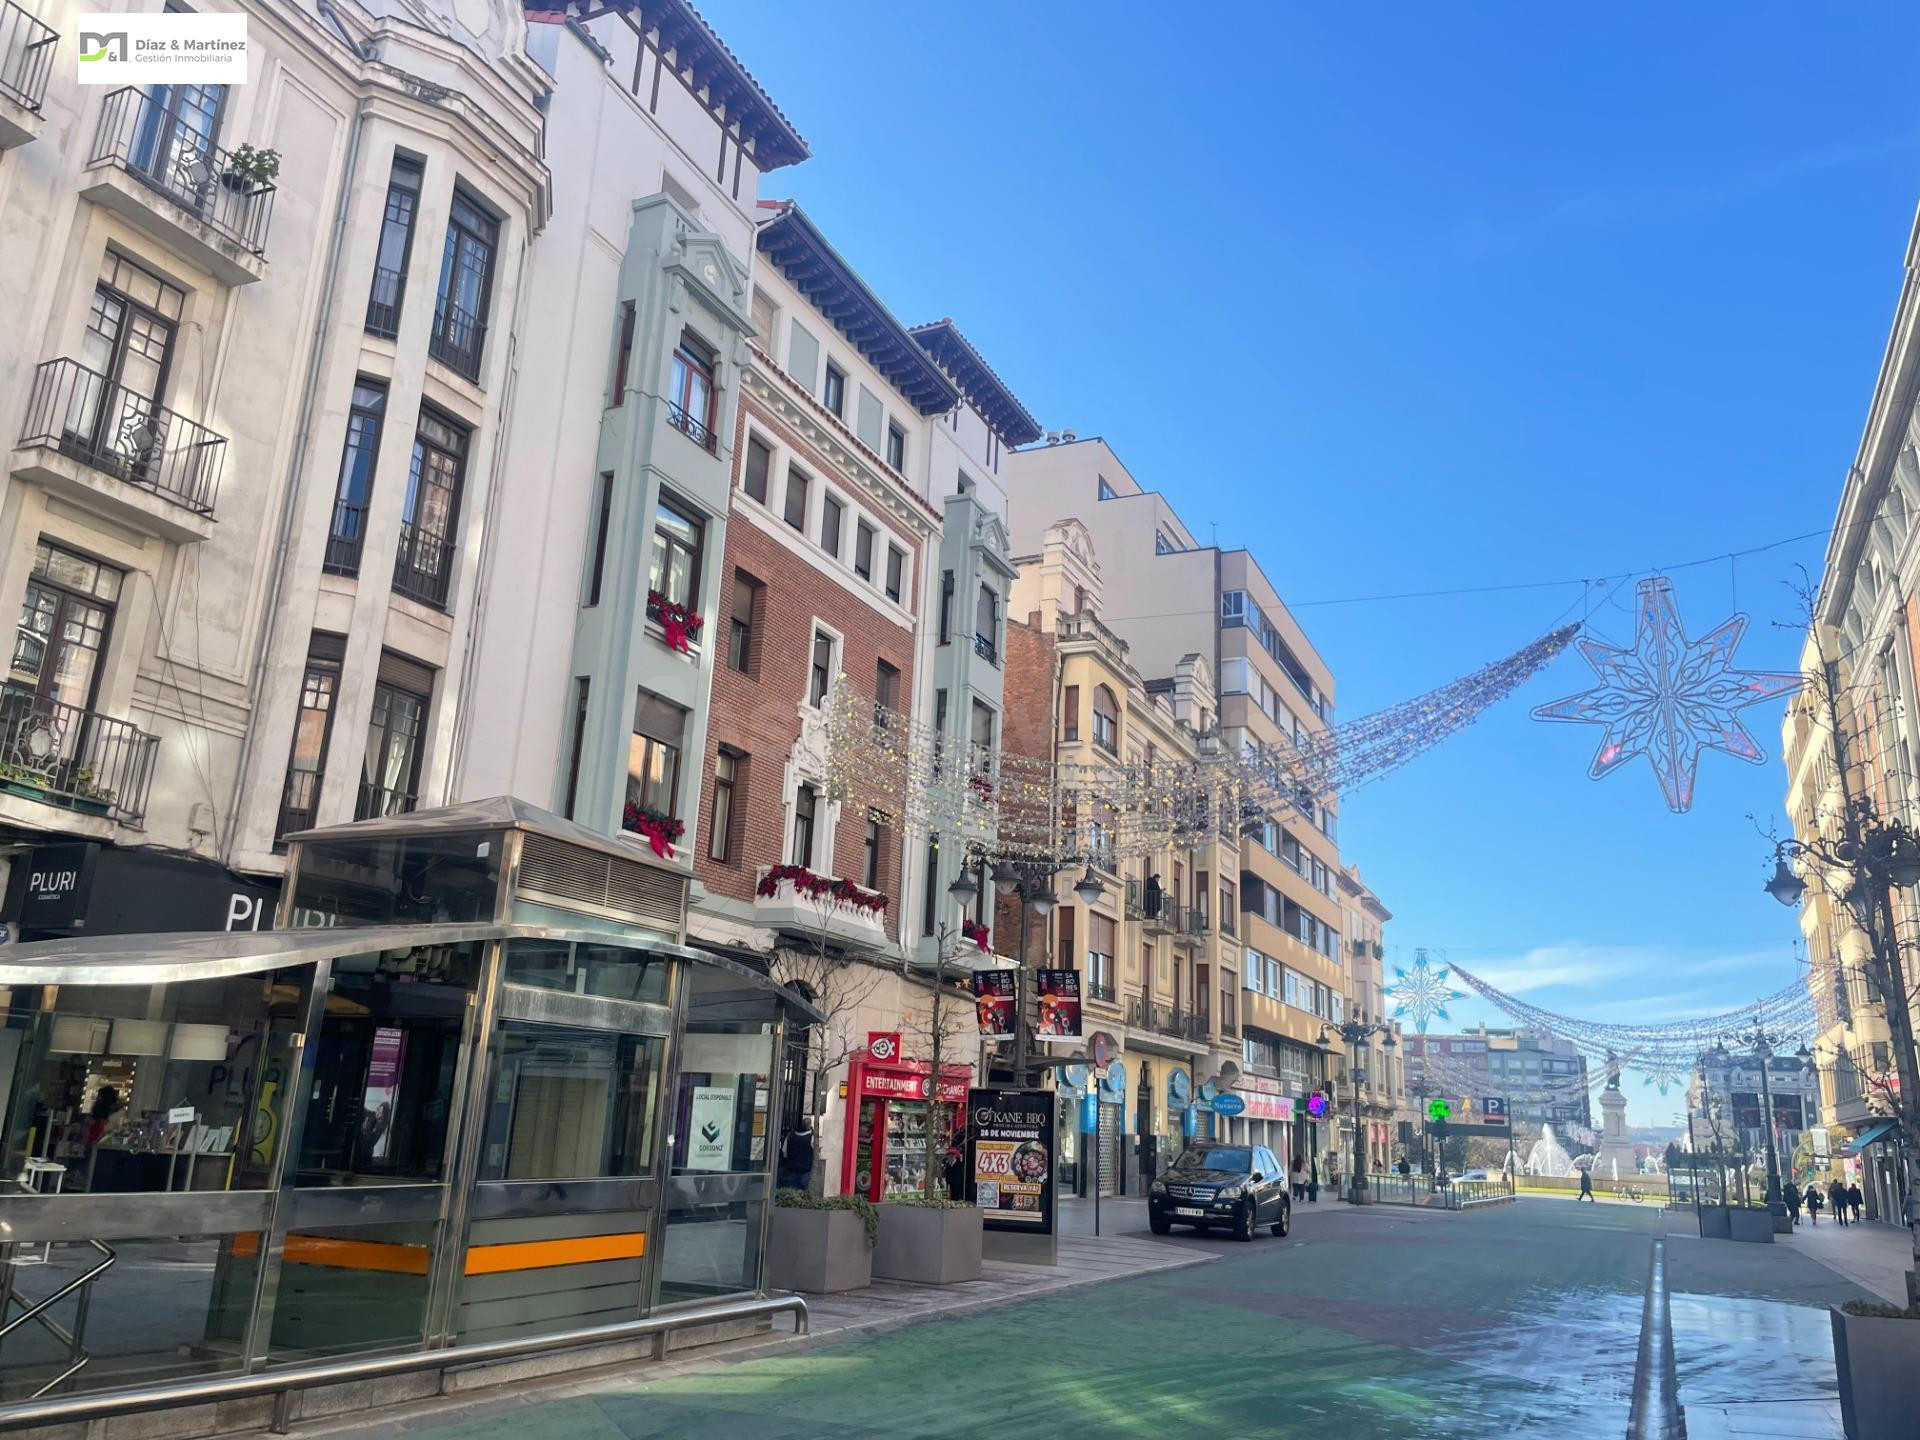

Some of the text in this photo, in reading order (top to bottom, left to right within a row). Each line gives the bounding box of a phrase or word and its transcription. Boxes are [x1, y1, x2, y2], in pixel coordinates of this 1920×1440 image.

[30, 871, 76, 892] PLURI
[866, 1076, 918, 1092] ENTERTAINMENT
[1488, 1099, 1499, 1114] P
[1026, 1112, 1046, 1126] BBQ
[990, 1129, 999, 1137] DE
[1000, 1130, 1040, 1139] NOVIEMBRE
